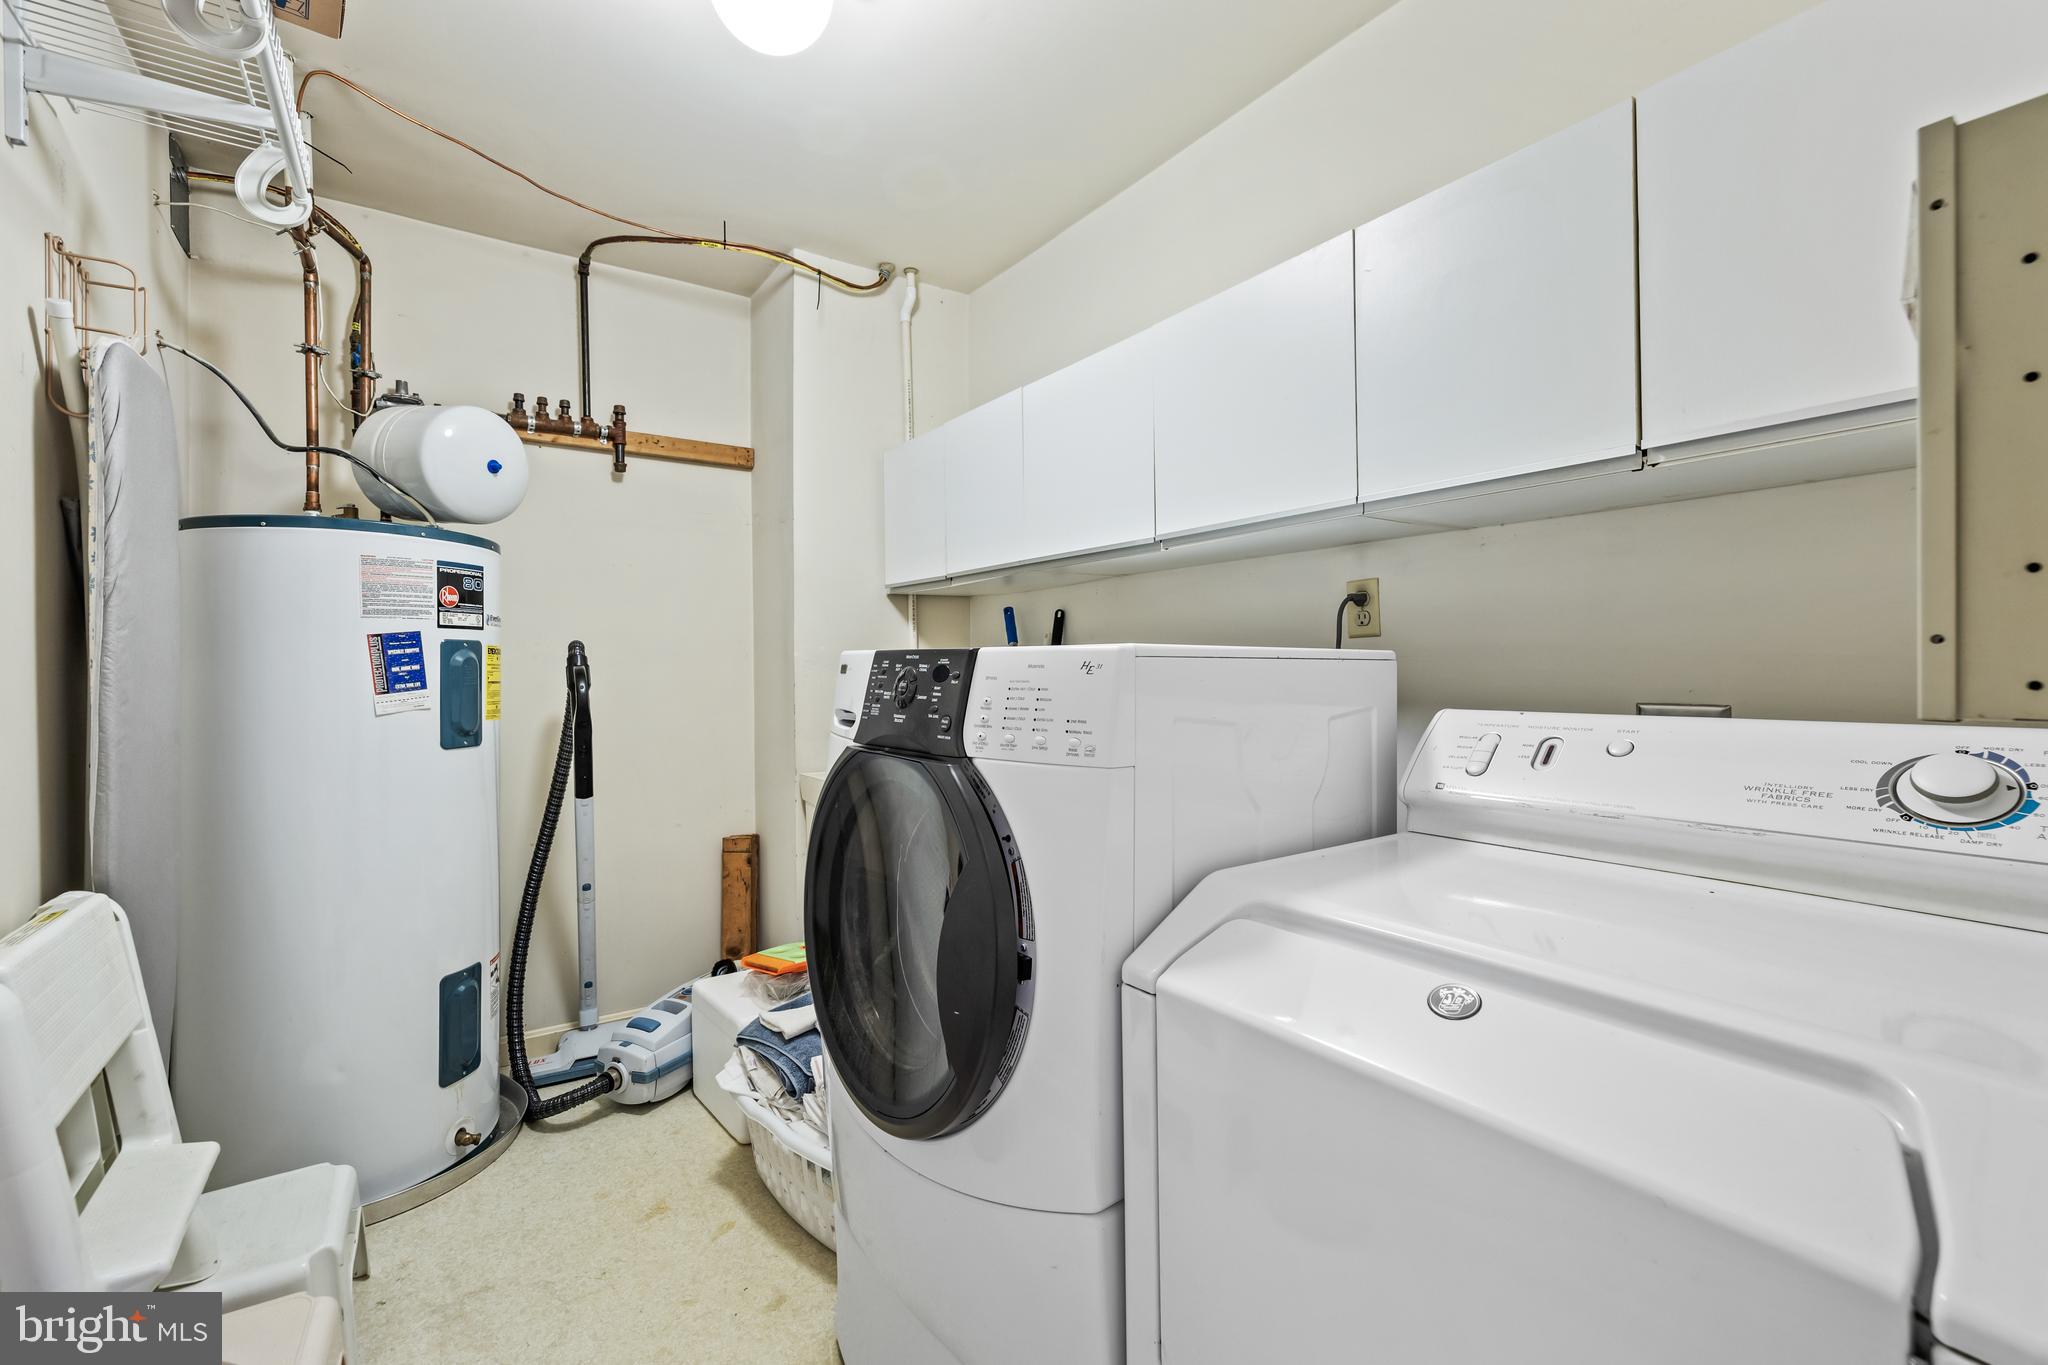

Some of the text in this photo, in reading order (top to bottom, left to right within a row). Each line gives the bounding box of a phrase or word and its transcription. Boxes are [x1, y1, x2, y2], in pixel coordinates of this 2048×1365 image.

[439, 567, 483, 577] PROFESSIONAL
[462, 576, 483, 592] 80
[1743, 785, 1834, 799] WRINKLE FREE
[1764, 782, 1814, 791] INTELLIDRY
[1760, 793, 1812, 803] FABRICS
[1872, 827, 1945, 840] WRINKLE RELEASE
